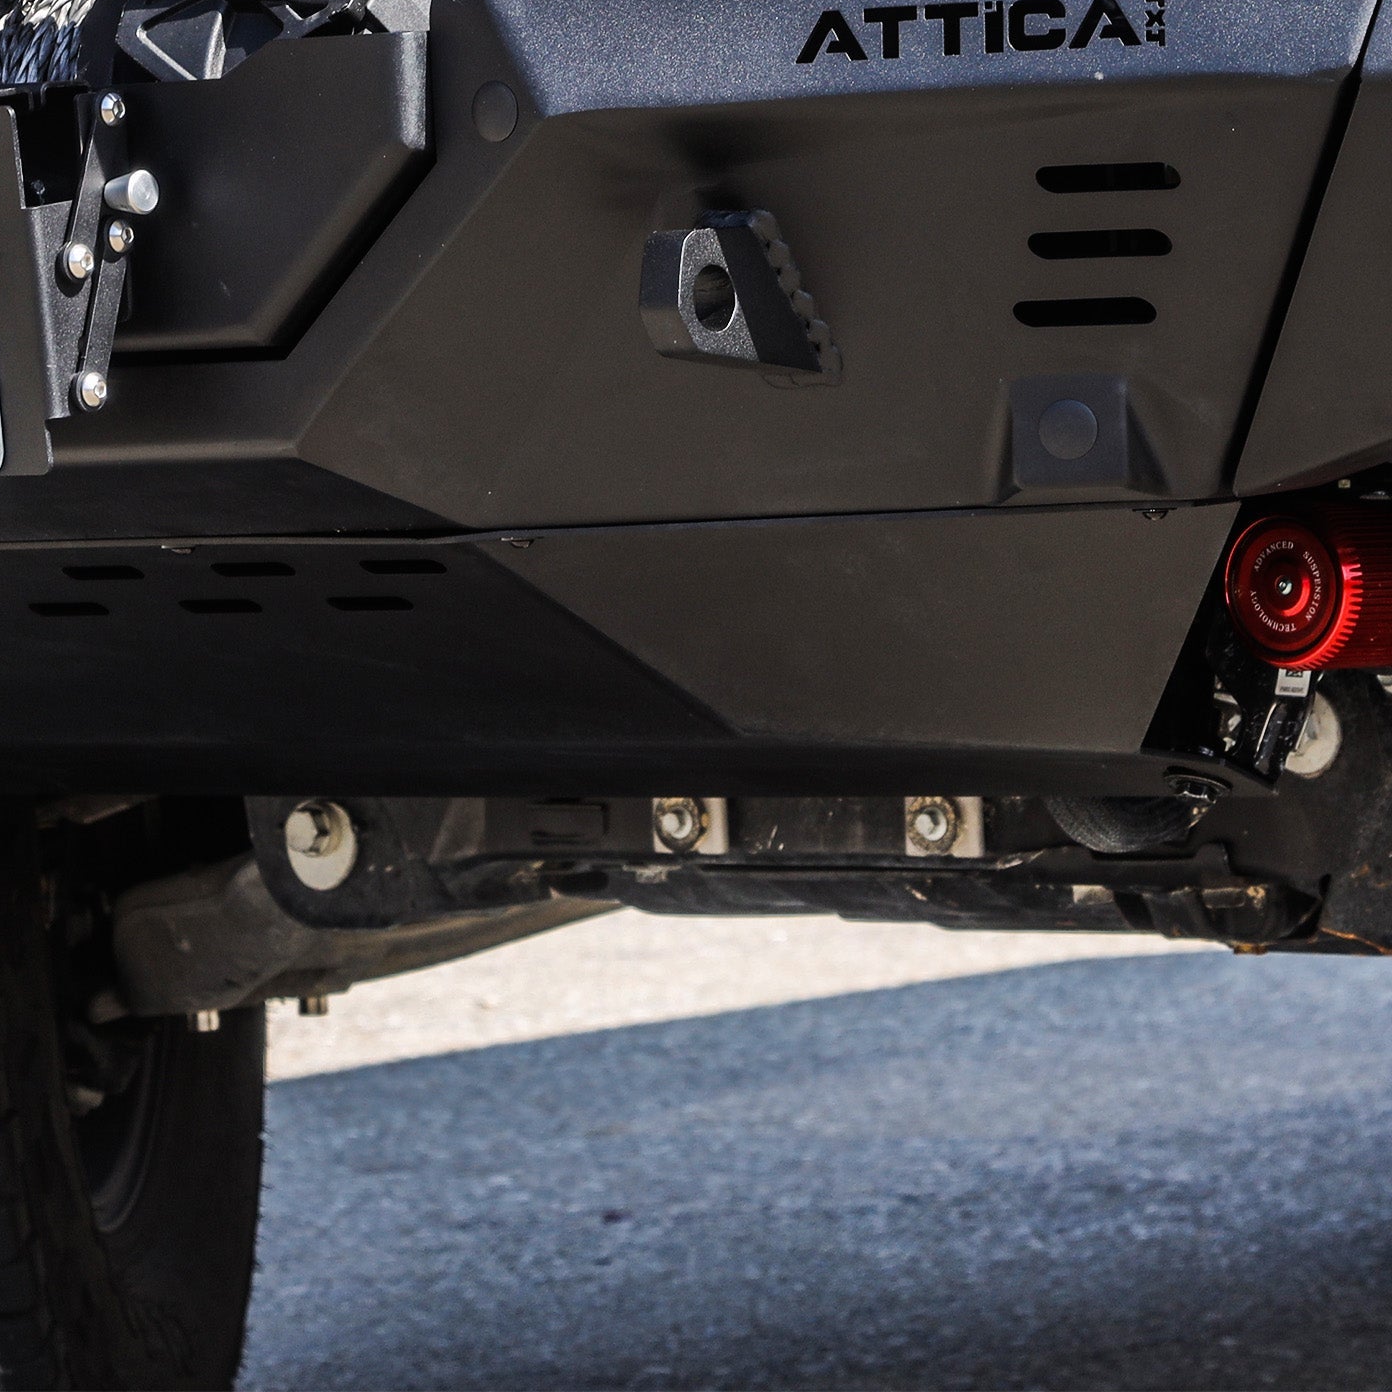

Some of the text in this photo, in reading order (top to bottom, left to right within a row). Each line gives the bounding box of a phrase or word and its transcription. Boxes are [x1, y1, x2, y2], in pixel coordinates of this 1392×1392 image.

[1250, 540, 1322, 633] ADVANCED SUSPENSION TECHNOLOGY
